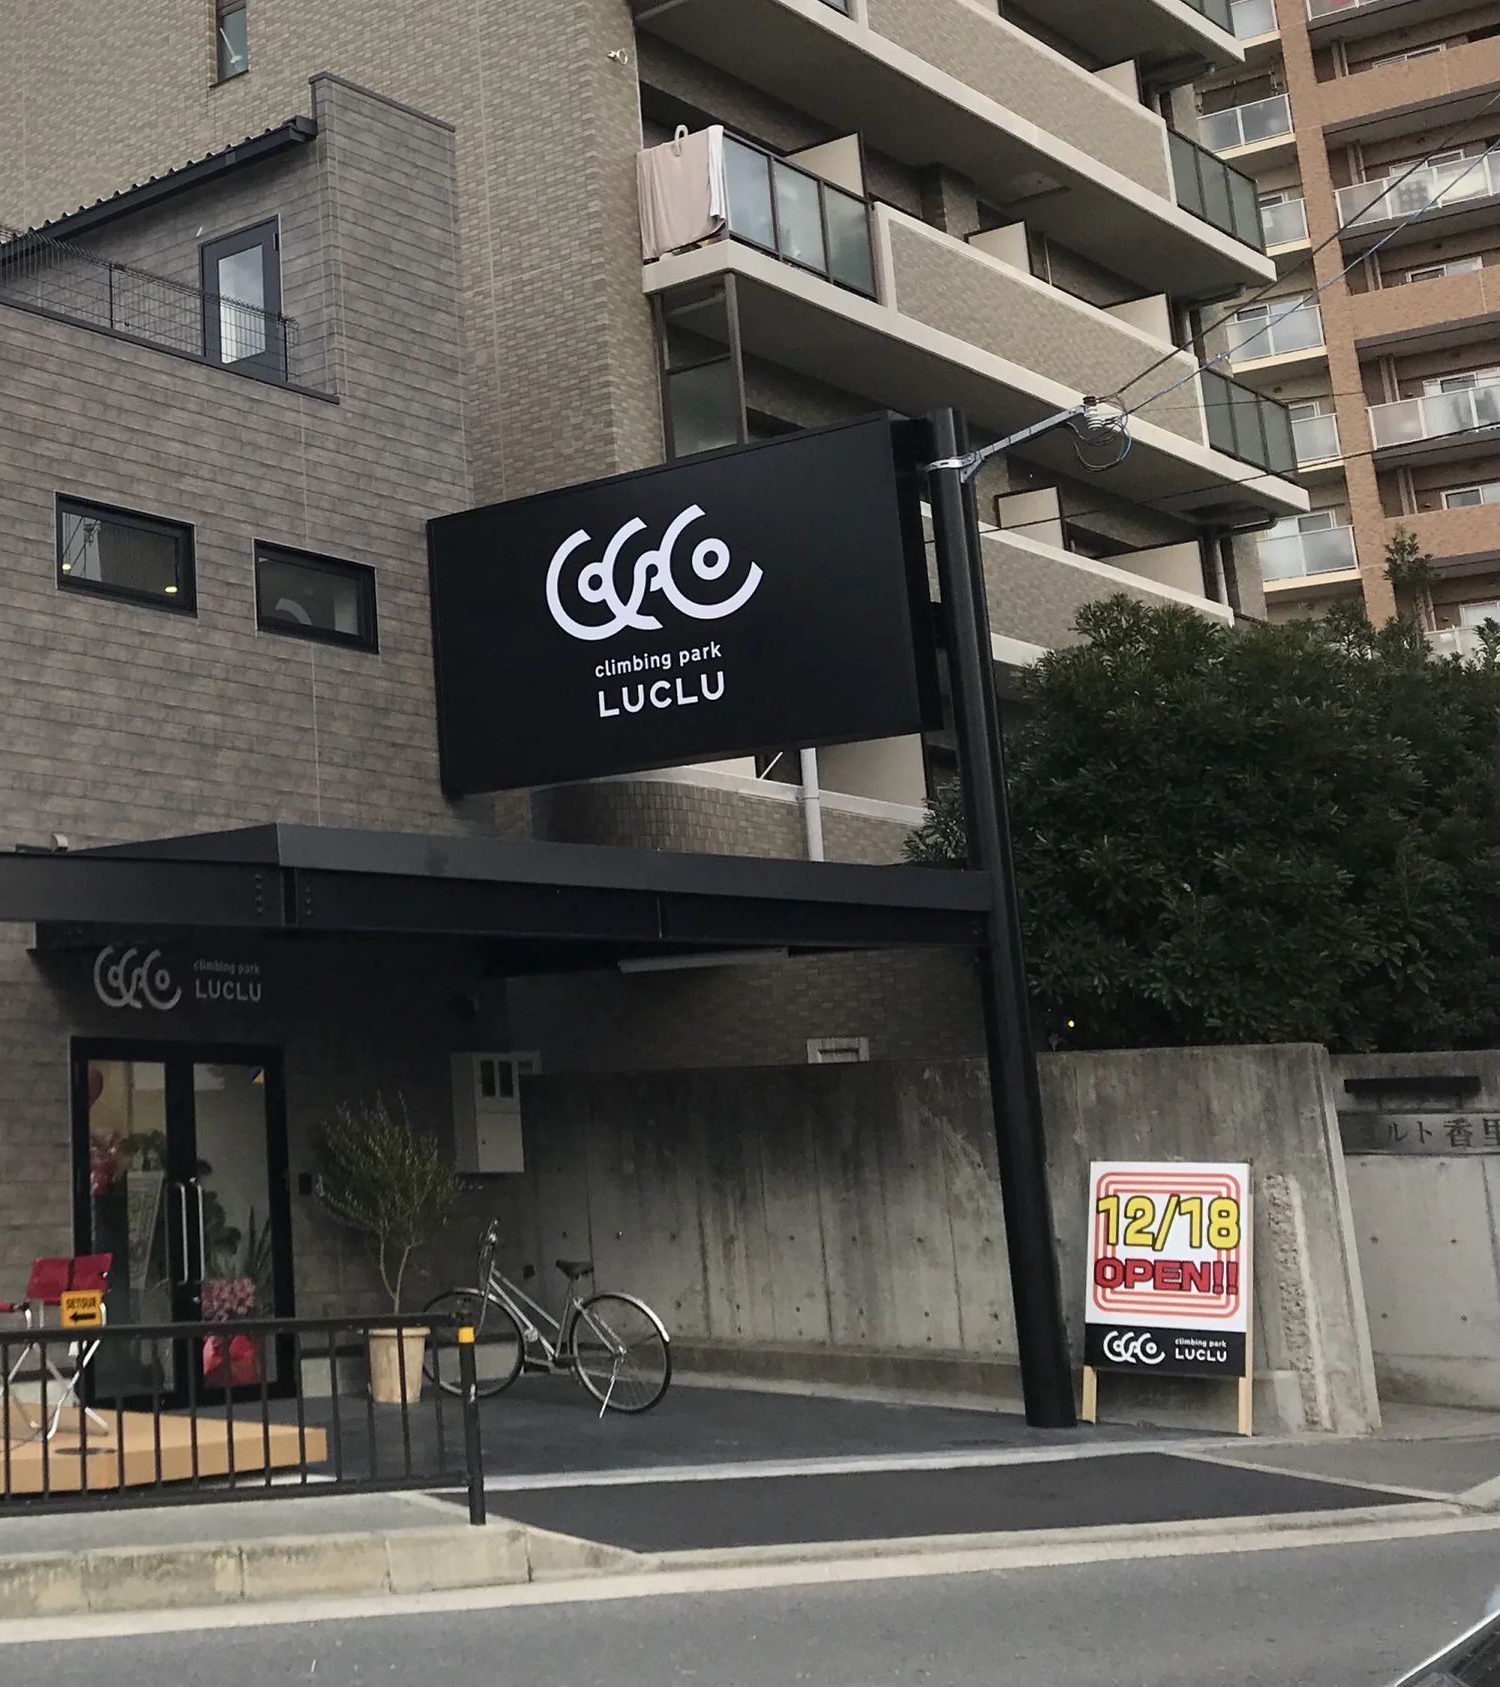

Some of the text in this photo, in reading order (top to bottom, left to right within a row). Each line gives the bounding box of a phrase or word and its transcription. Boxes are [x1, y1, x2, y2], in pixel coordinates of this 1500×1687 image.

[595, 641, 722, 678] climbing park
[598, 671, 725, 718] LUCLU
[193, 958, 260, 976] climbing park
[195, 979, 262, 1002] LUCLU
[1096, 1194, 1241, 1251] 12/18
[1094, 1257, 1239, 1296] OPEN!!
[1175, 1338, 1227, 1348] climbing park
[1175, 1348, 1227, 1362] LUCLU
